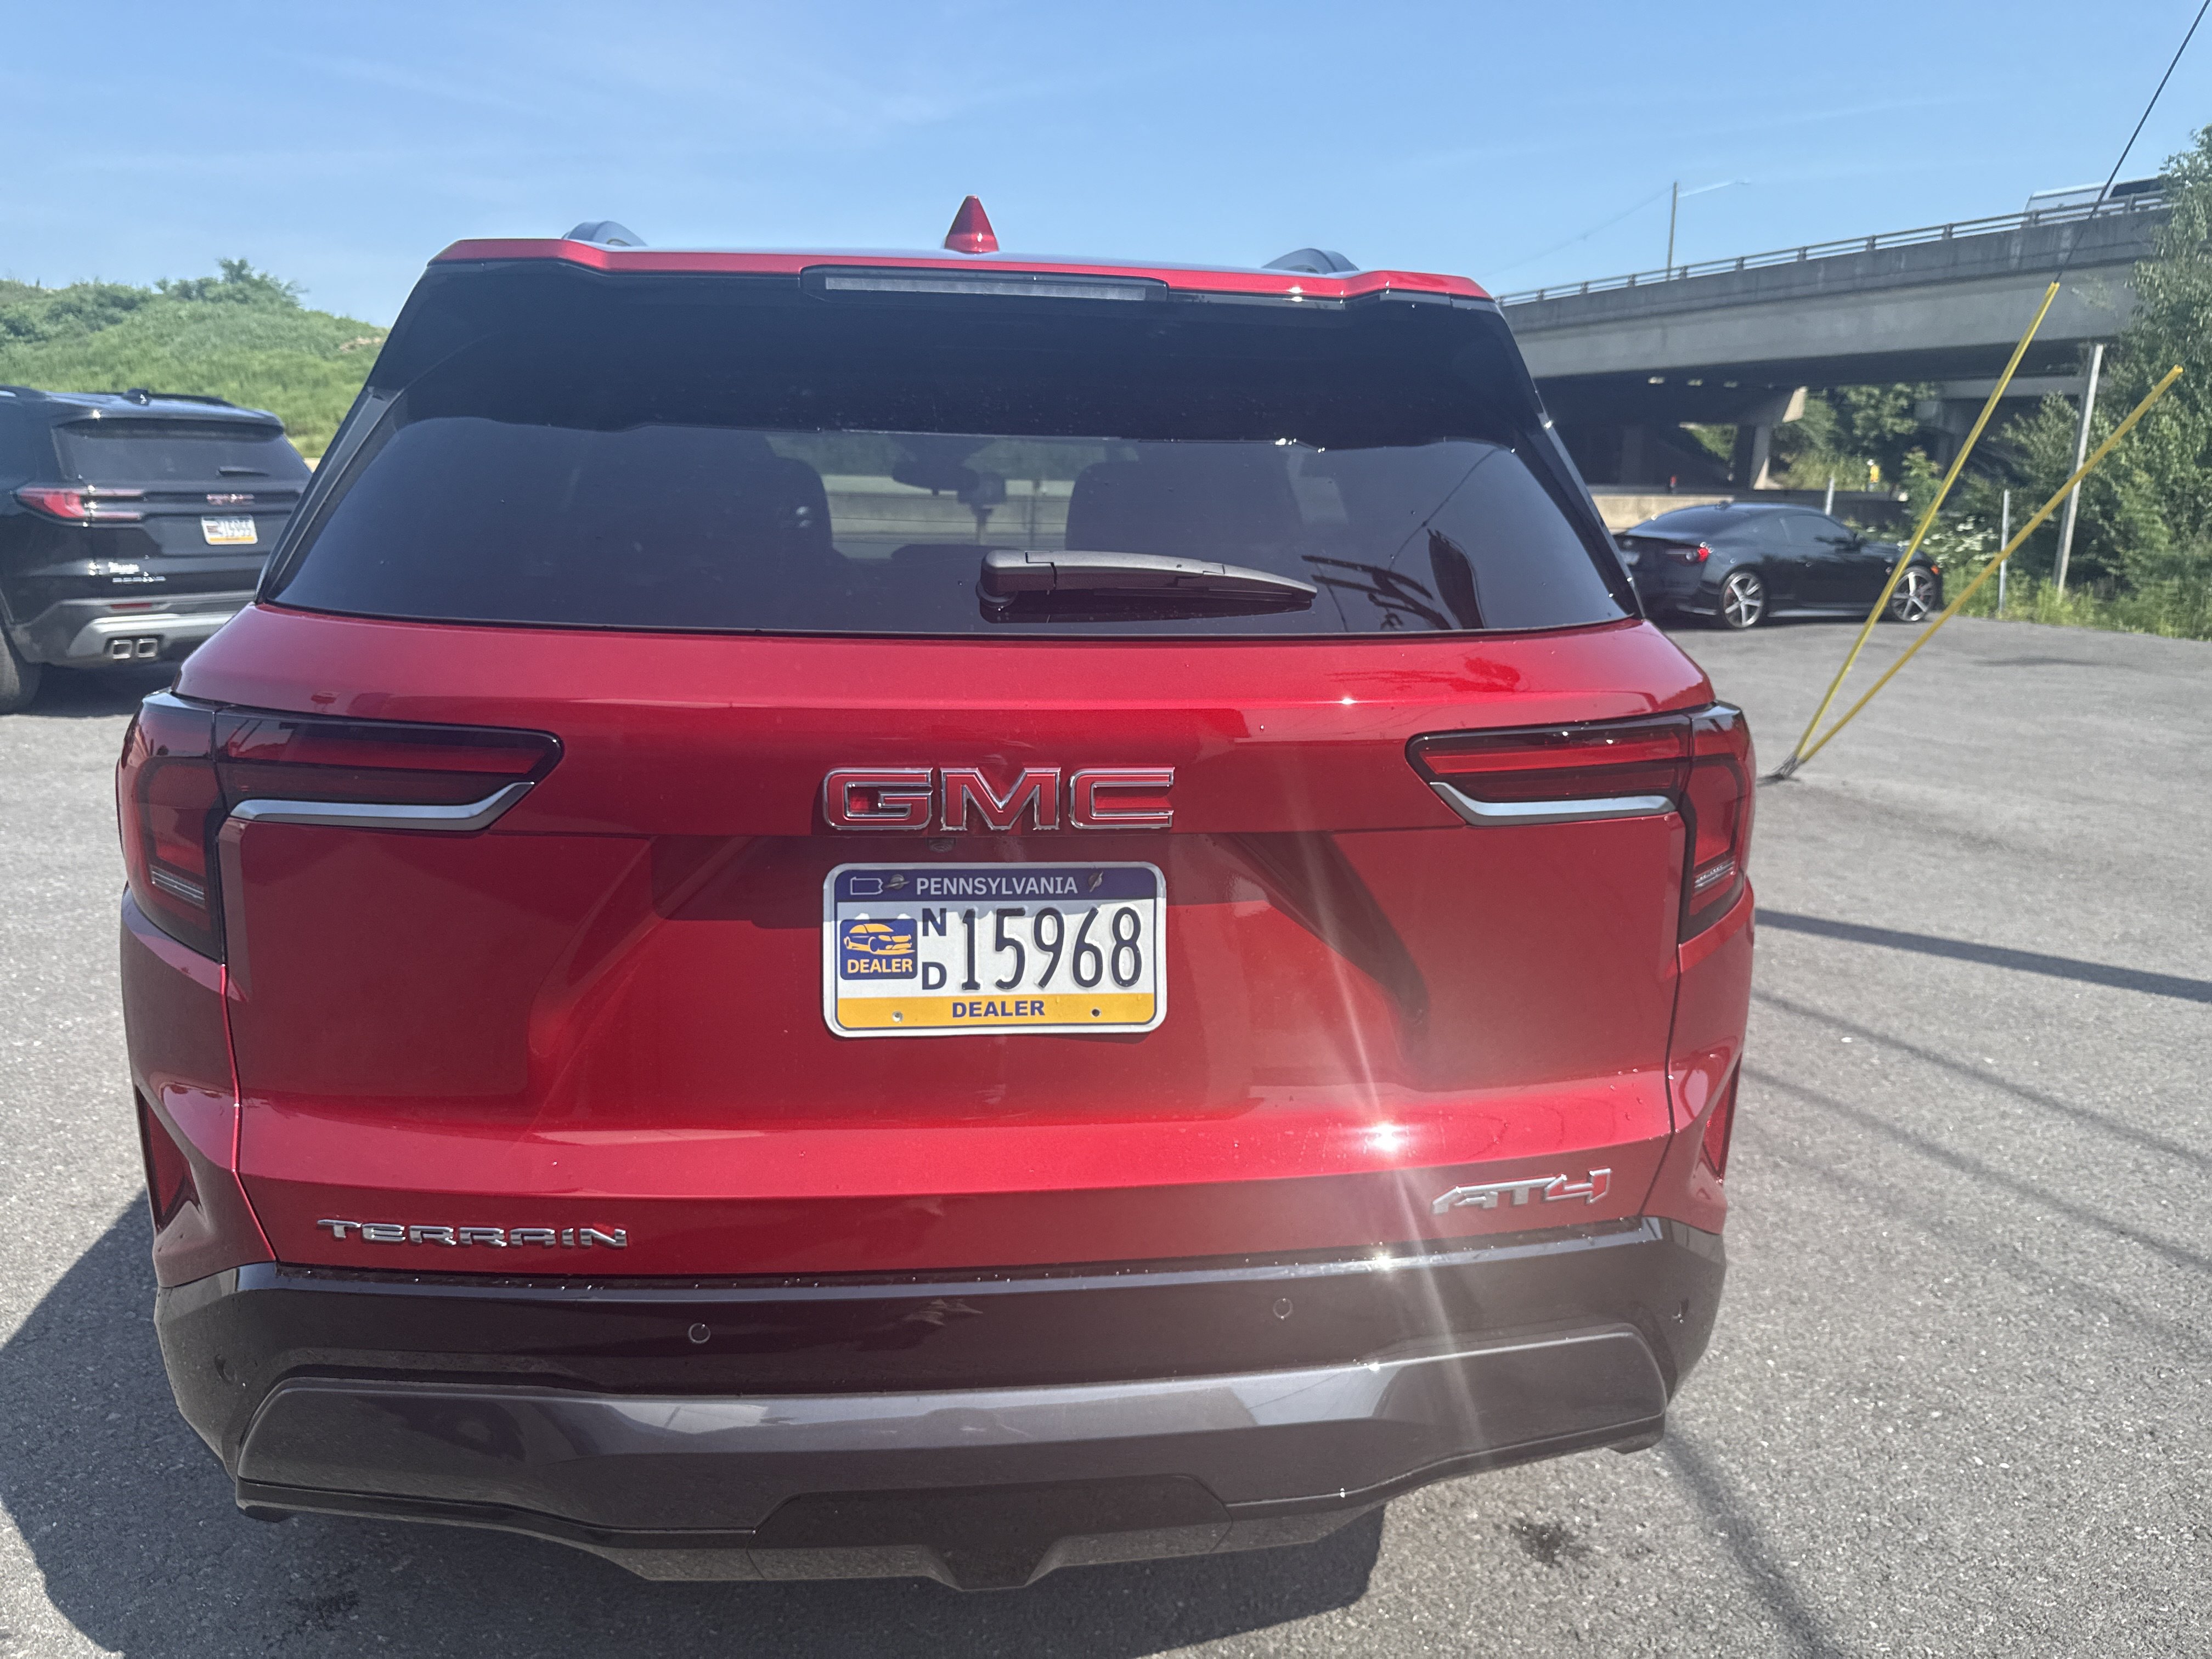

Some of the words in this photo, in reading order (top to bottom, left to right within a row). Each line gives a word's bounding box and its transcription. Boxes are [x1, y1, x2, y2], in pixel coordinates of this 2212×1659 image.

[823, 767, 1175, 831] GMC
[916, 877, 1078, 895] PENNSYLVANIA
[961, 906, 1143, 990] 15968
[847, 958, 913, 974] DEALER
[951, 1000, 1046, 1019] DEALER
[1432, 1167, 1611, 1214] AT4
[317, 1218, 628, 1248] TERRAIN
